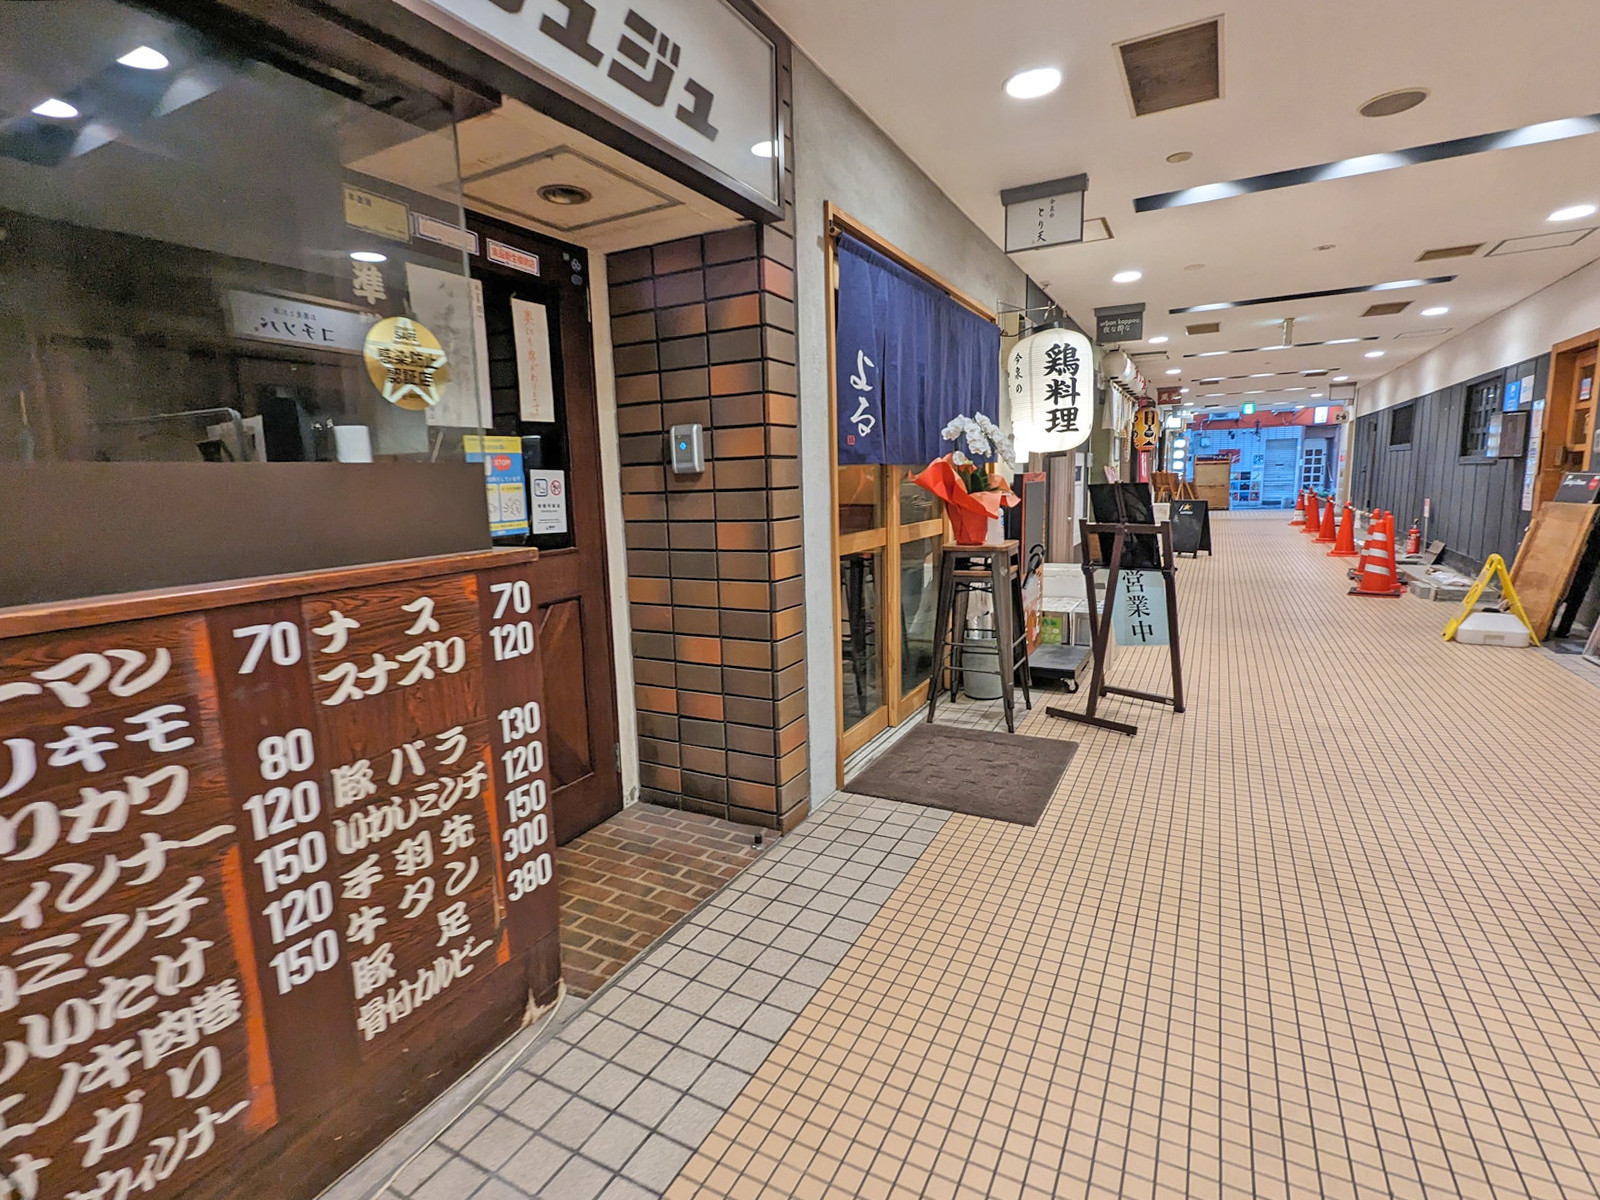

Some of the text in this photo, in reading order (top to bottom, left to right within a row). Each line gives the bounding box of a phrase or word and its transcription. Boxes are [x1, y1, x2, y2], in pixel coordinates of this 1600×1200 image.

[487, 0, 719, 142] ュジュ
[1036, 207, 1047, 242] とり天
[850, 350, 876, 437] よる
[1043, 342, 1081, 433] 鶏料理
[490, 580, 532, 620] 70
[1122, 570, 1154, 643] 営業中
[233, 620, 302, 675] 70
[318, 636, 466, 706] スナズリ
[489, 621, 534, 661] 120
[498, 701, 541, 743] 130
[257, 728, 315, 781] 80
[330, 726, 468, 808] 豚バラ
[501, 740, 544, 783] 120
[243, 780, 321, 842] 120
[332, 761, 488, 855] いわしミンチ
[505, 779, 547, 823] 150
[254, 831, 328, 893] 150
[340, 814, 475, 899] 手羽先
[502, 813, 548, 862] 300
[346, 856, 480, 945] 牛タン
[507, 853, 553, 901] 380
[0, 876, 209, 1013] ミンチ
[262, 881, 335, 945] 120
[269, 929, 339, 995] 150
[357, 936, 494, 1041] 骨付カルビー
